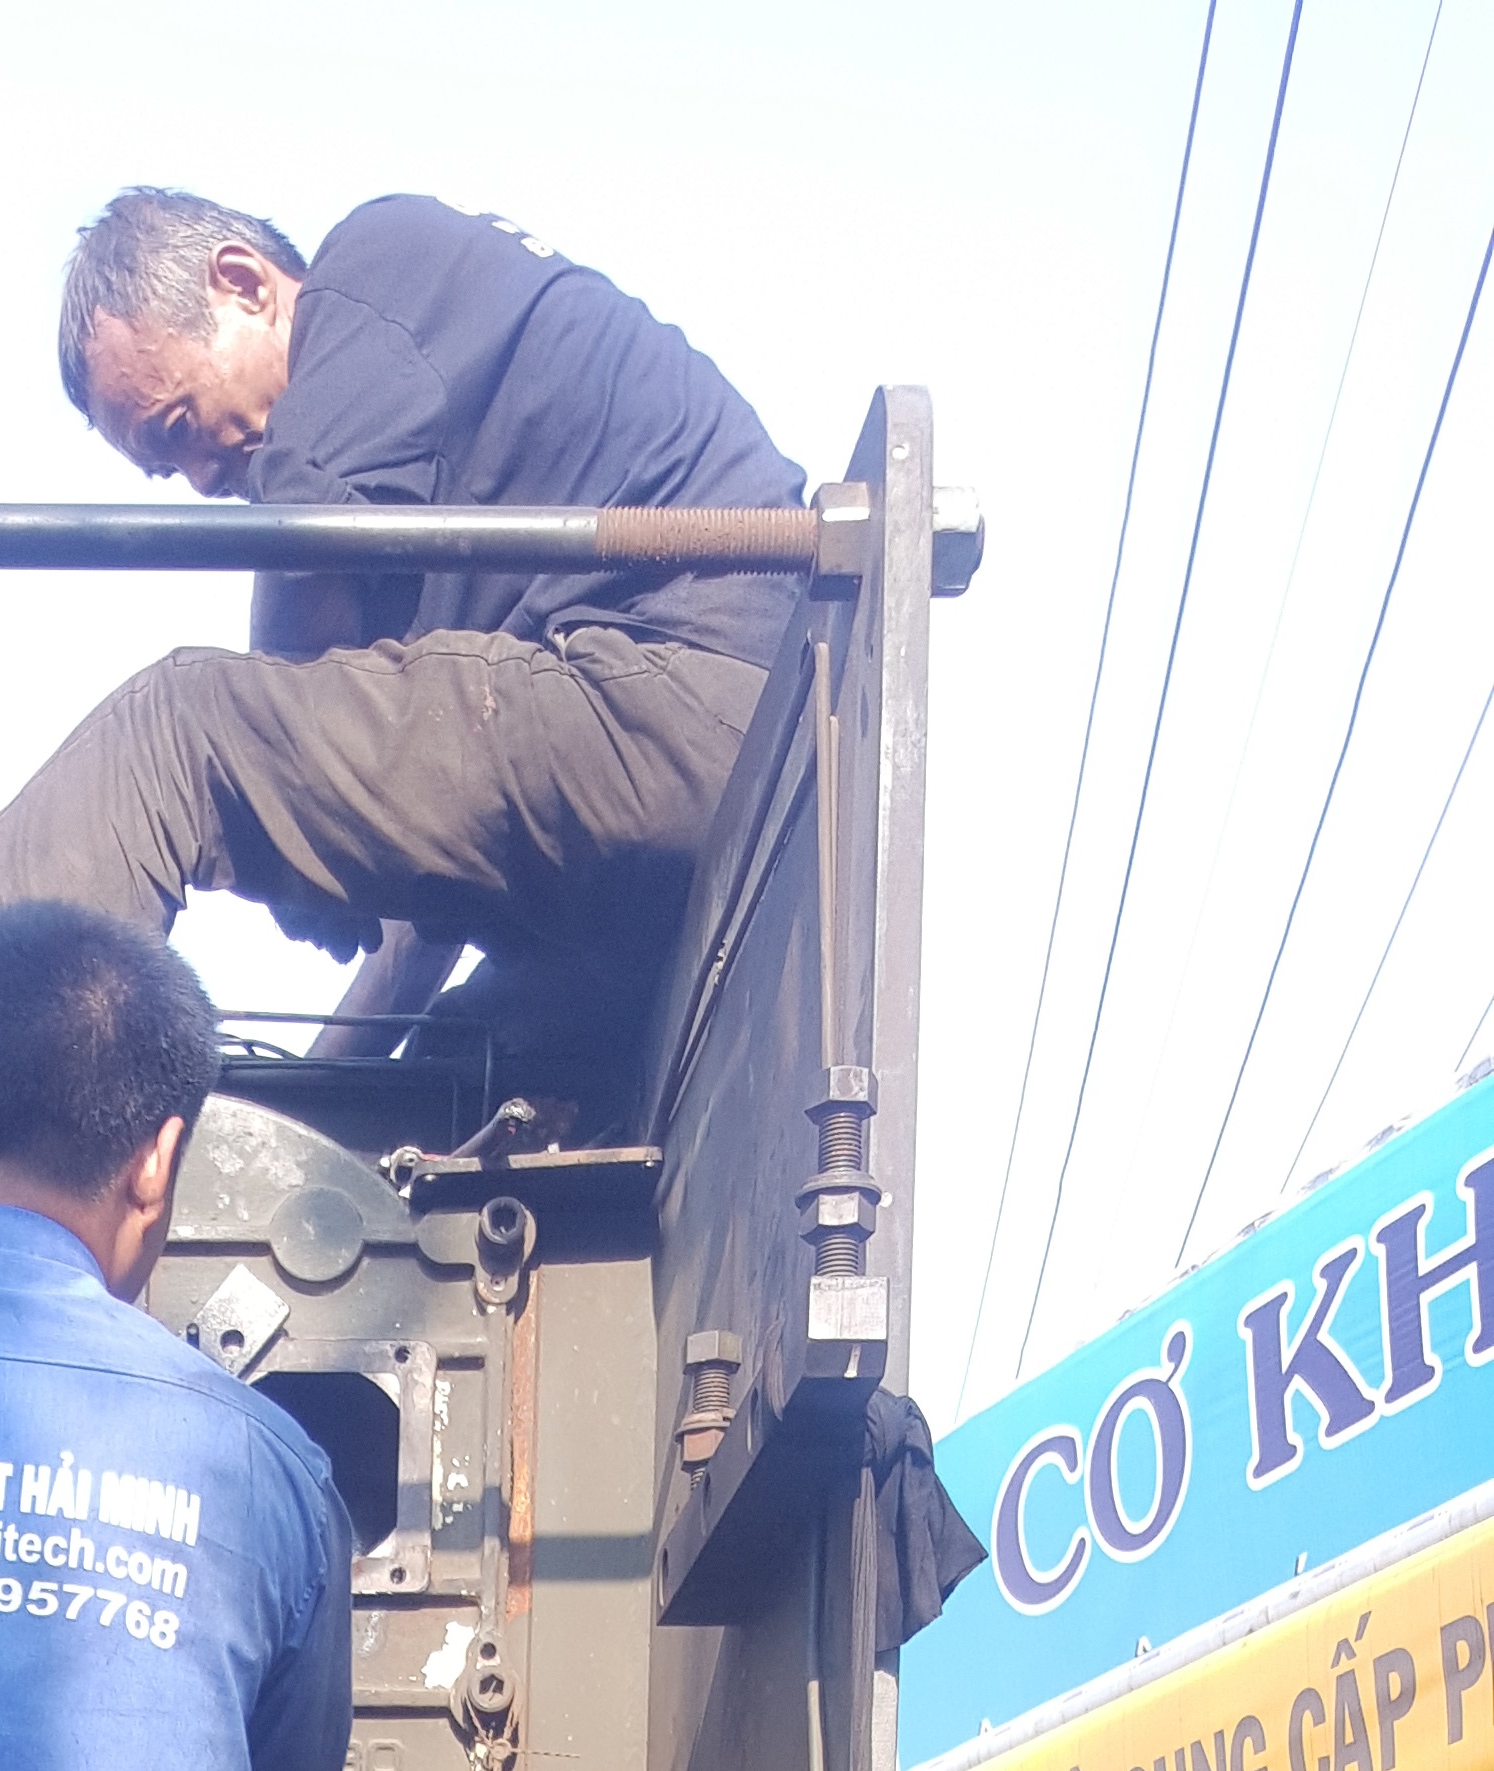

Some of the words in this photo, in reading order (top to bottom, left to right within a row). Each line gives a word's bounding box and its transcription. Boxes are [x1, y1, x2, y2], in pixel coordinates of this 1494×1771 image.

[20, 1450, 91, 1520] HẢI
[101, 1471, 201, 1546] MINH
[996, 1331, 1188, 1605] CƠ
[1440, 1601, 1494, 1745] P
